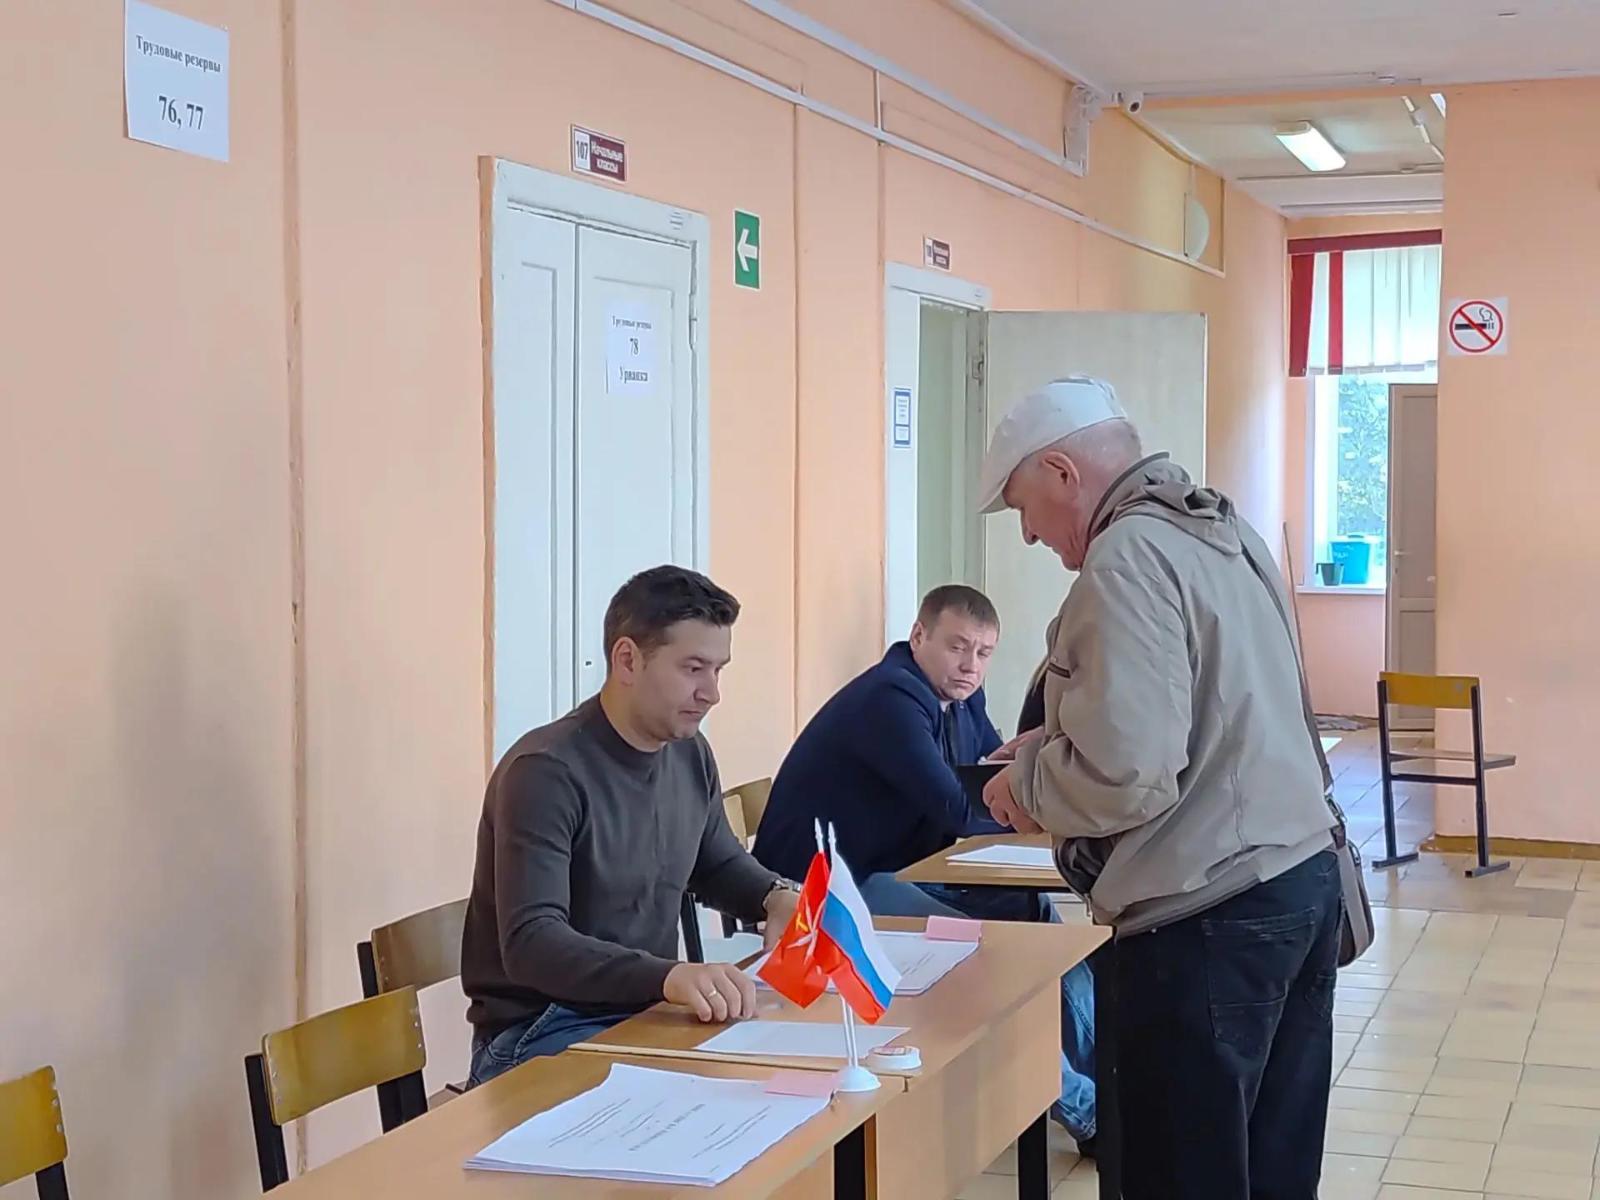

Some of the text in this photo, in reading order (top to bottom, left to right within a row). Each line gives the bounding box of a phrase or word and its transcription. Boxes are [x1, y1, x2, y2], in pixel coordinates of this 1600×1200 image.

[136, 34, 221, 73] Трудовые резервы
[158, 95, 204, 130] 76, 77
[576, 140, 588, 160] 107
[629, 338, 639, 356] 78
